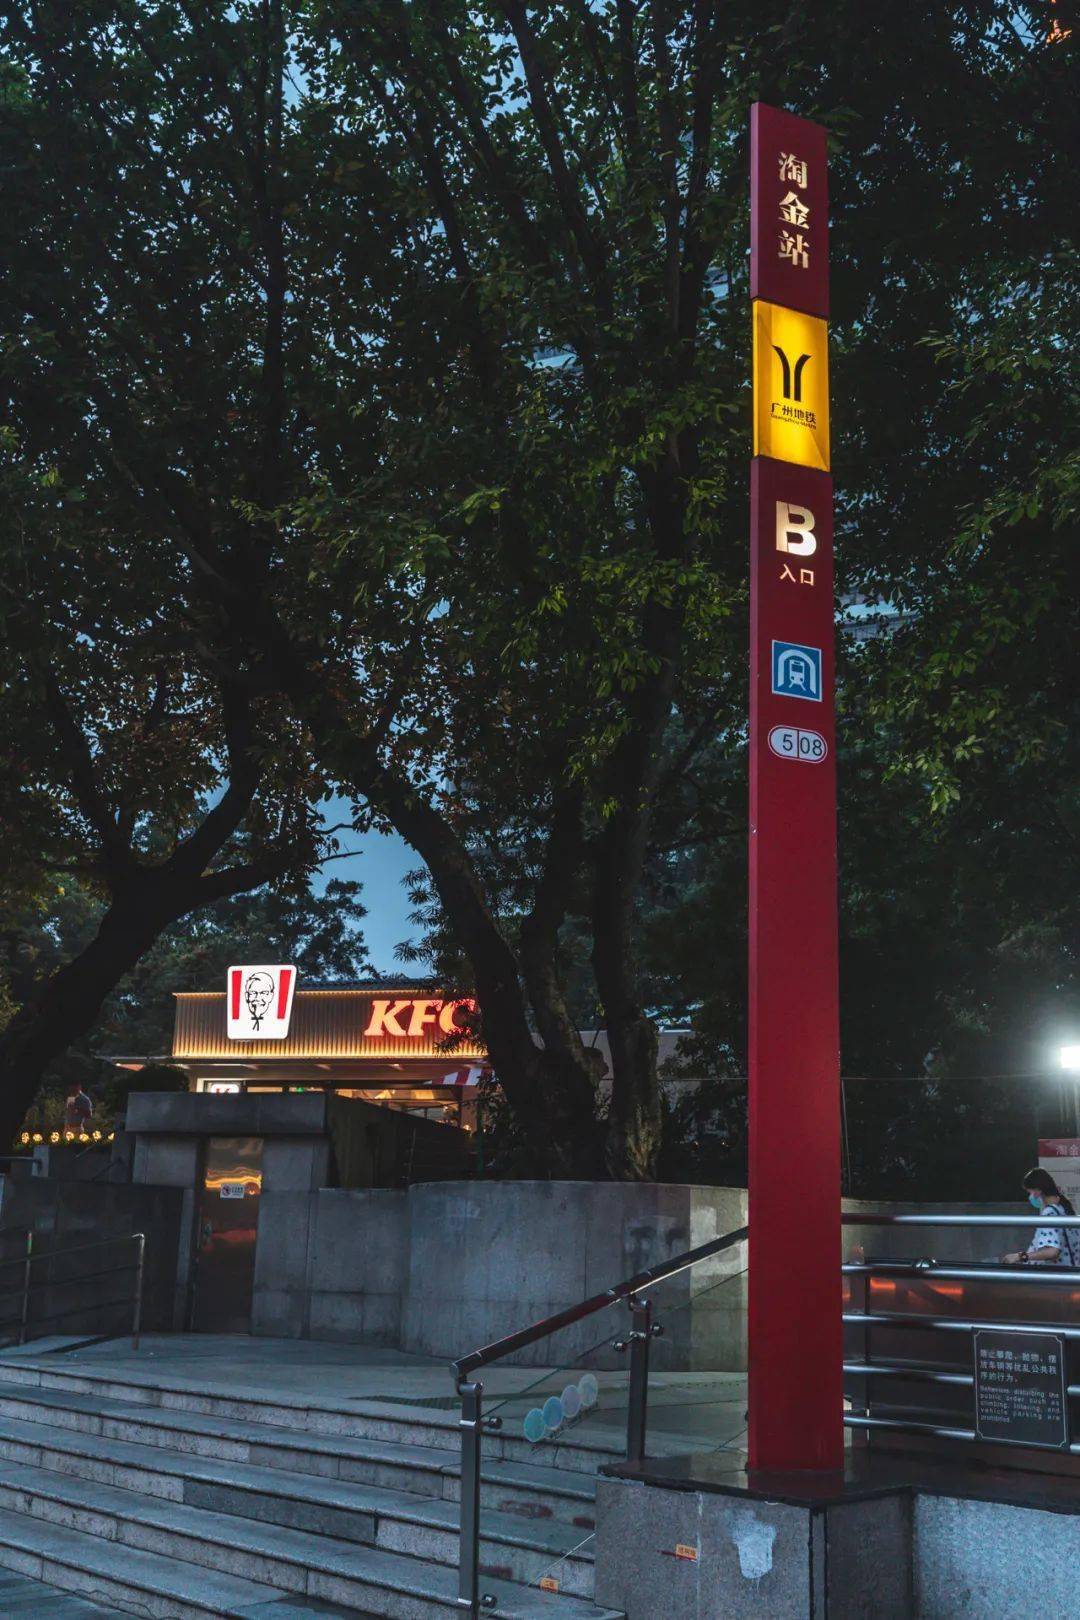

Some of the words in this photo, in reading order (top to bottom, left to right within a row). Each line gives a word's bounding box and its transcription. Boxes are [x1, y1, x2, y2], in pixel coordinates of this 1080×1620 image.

[778, 152, 810, 269] 淘金站
[771, 402, 817, 424] 广州地铁
[776, 500, 817, 557] B
[779, 563, 815, 586] 入口
[782, 734, 793, 752] 5
[800, 736, 823, 757] 08
[364, 999, 476, 1038] KFC
